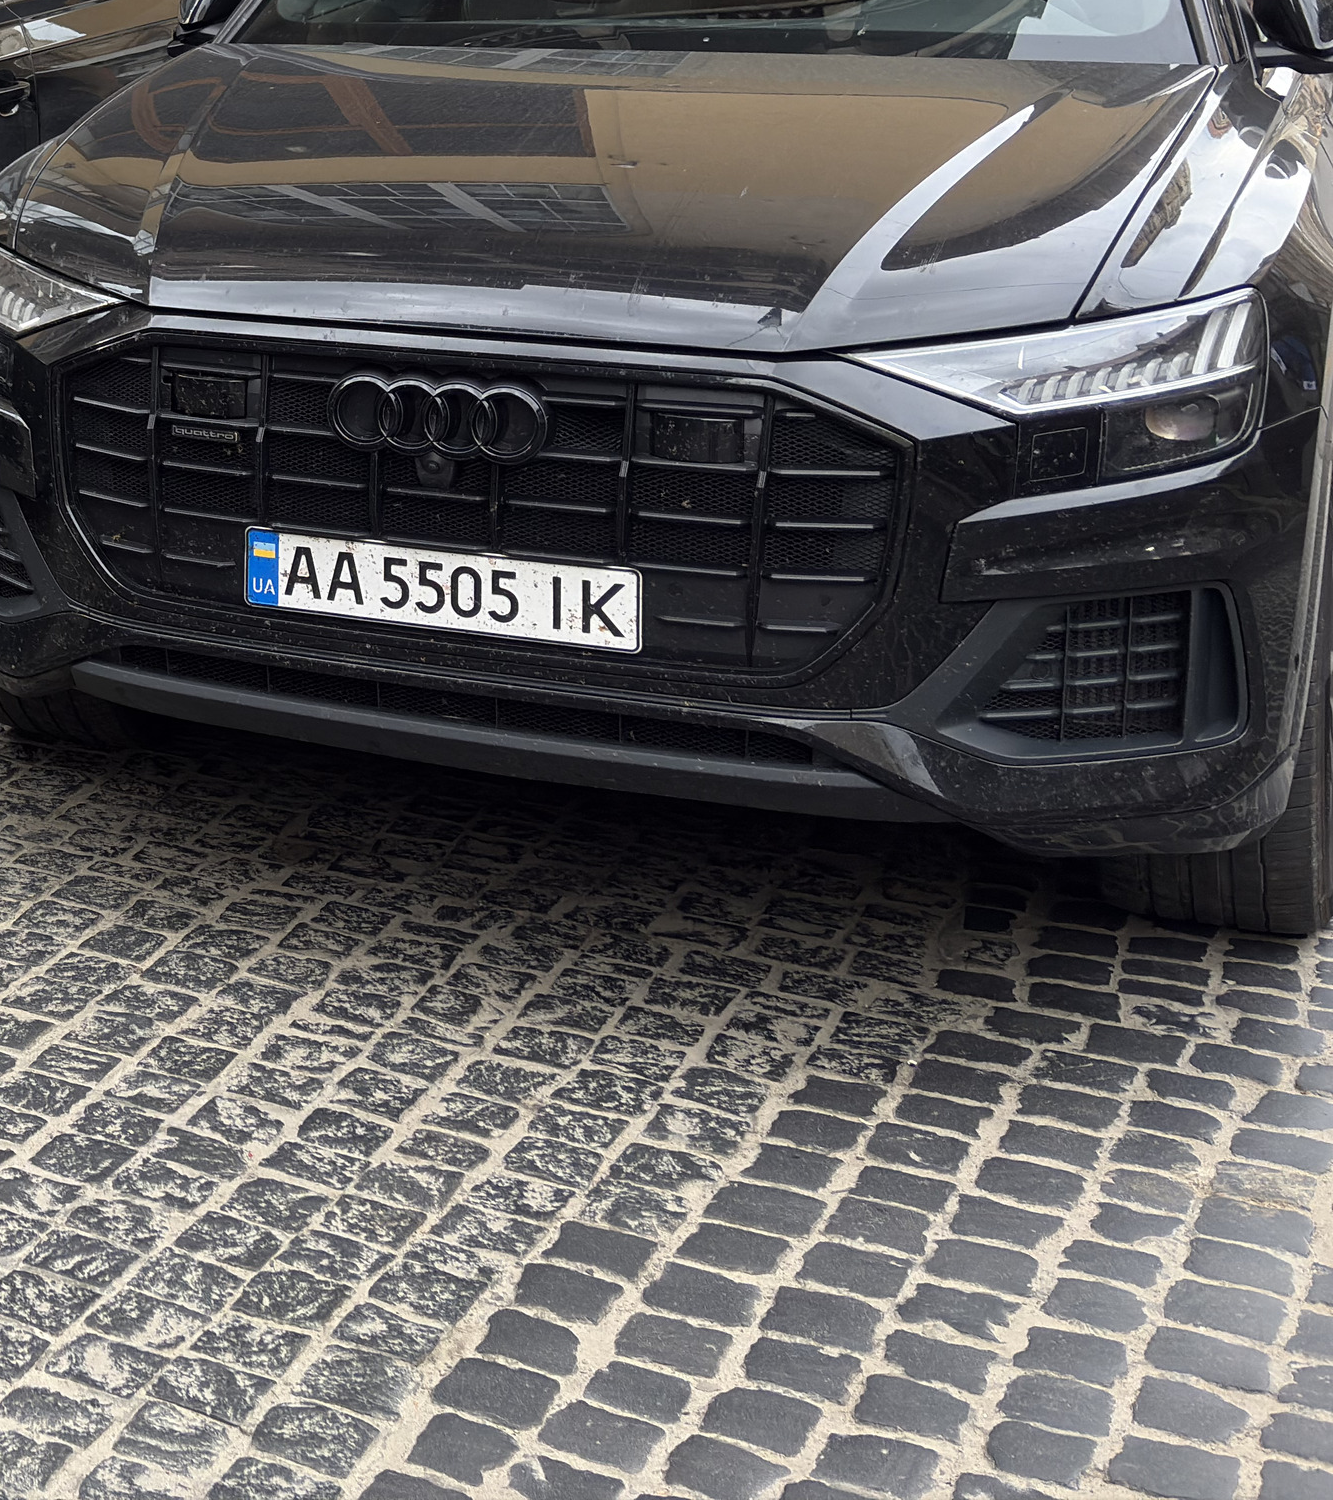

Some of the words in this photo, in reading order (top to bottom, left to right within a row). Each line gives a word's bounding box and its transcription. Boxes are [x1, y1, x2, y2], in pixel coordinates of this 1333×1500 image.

[174, 428, 234, 440] quattro
[252, 577, 276, 596] UA
[284, 546, 365, 606] AA
[380, 557, 519, 623] 5505
[551, 576, 626, 638] IK
